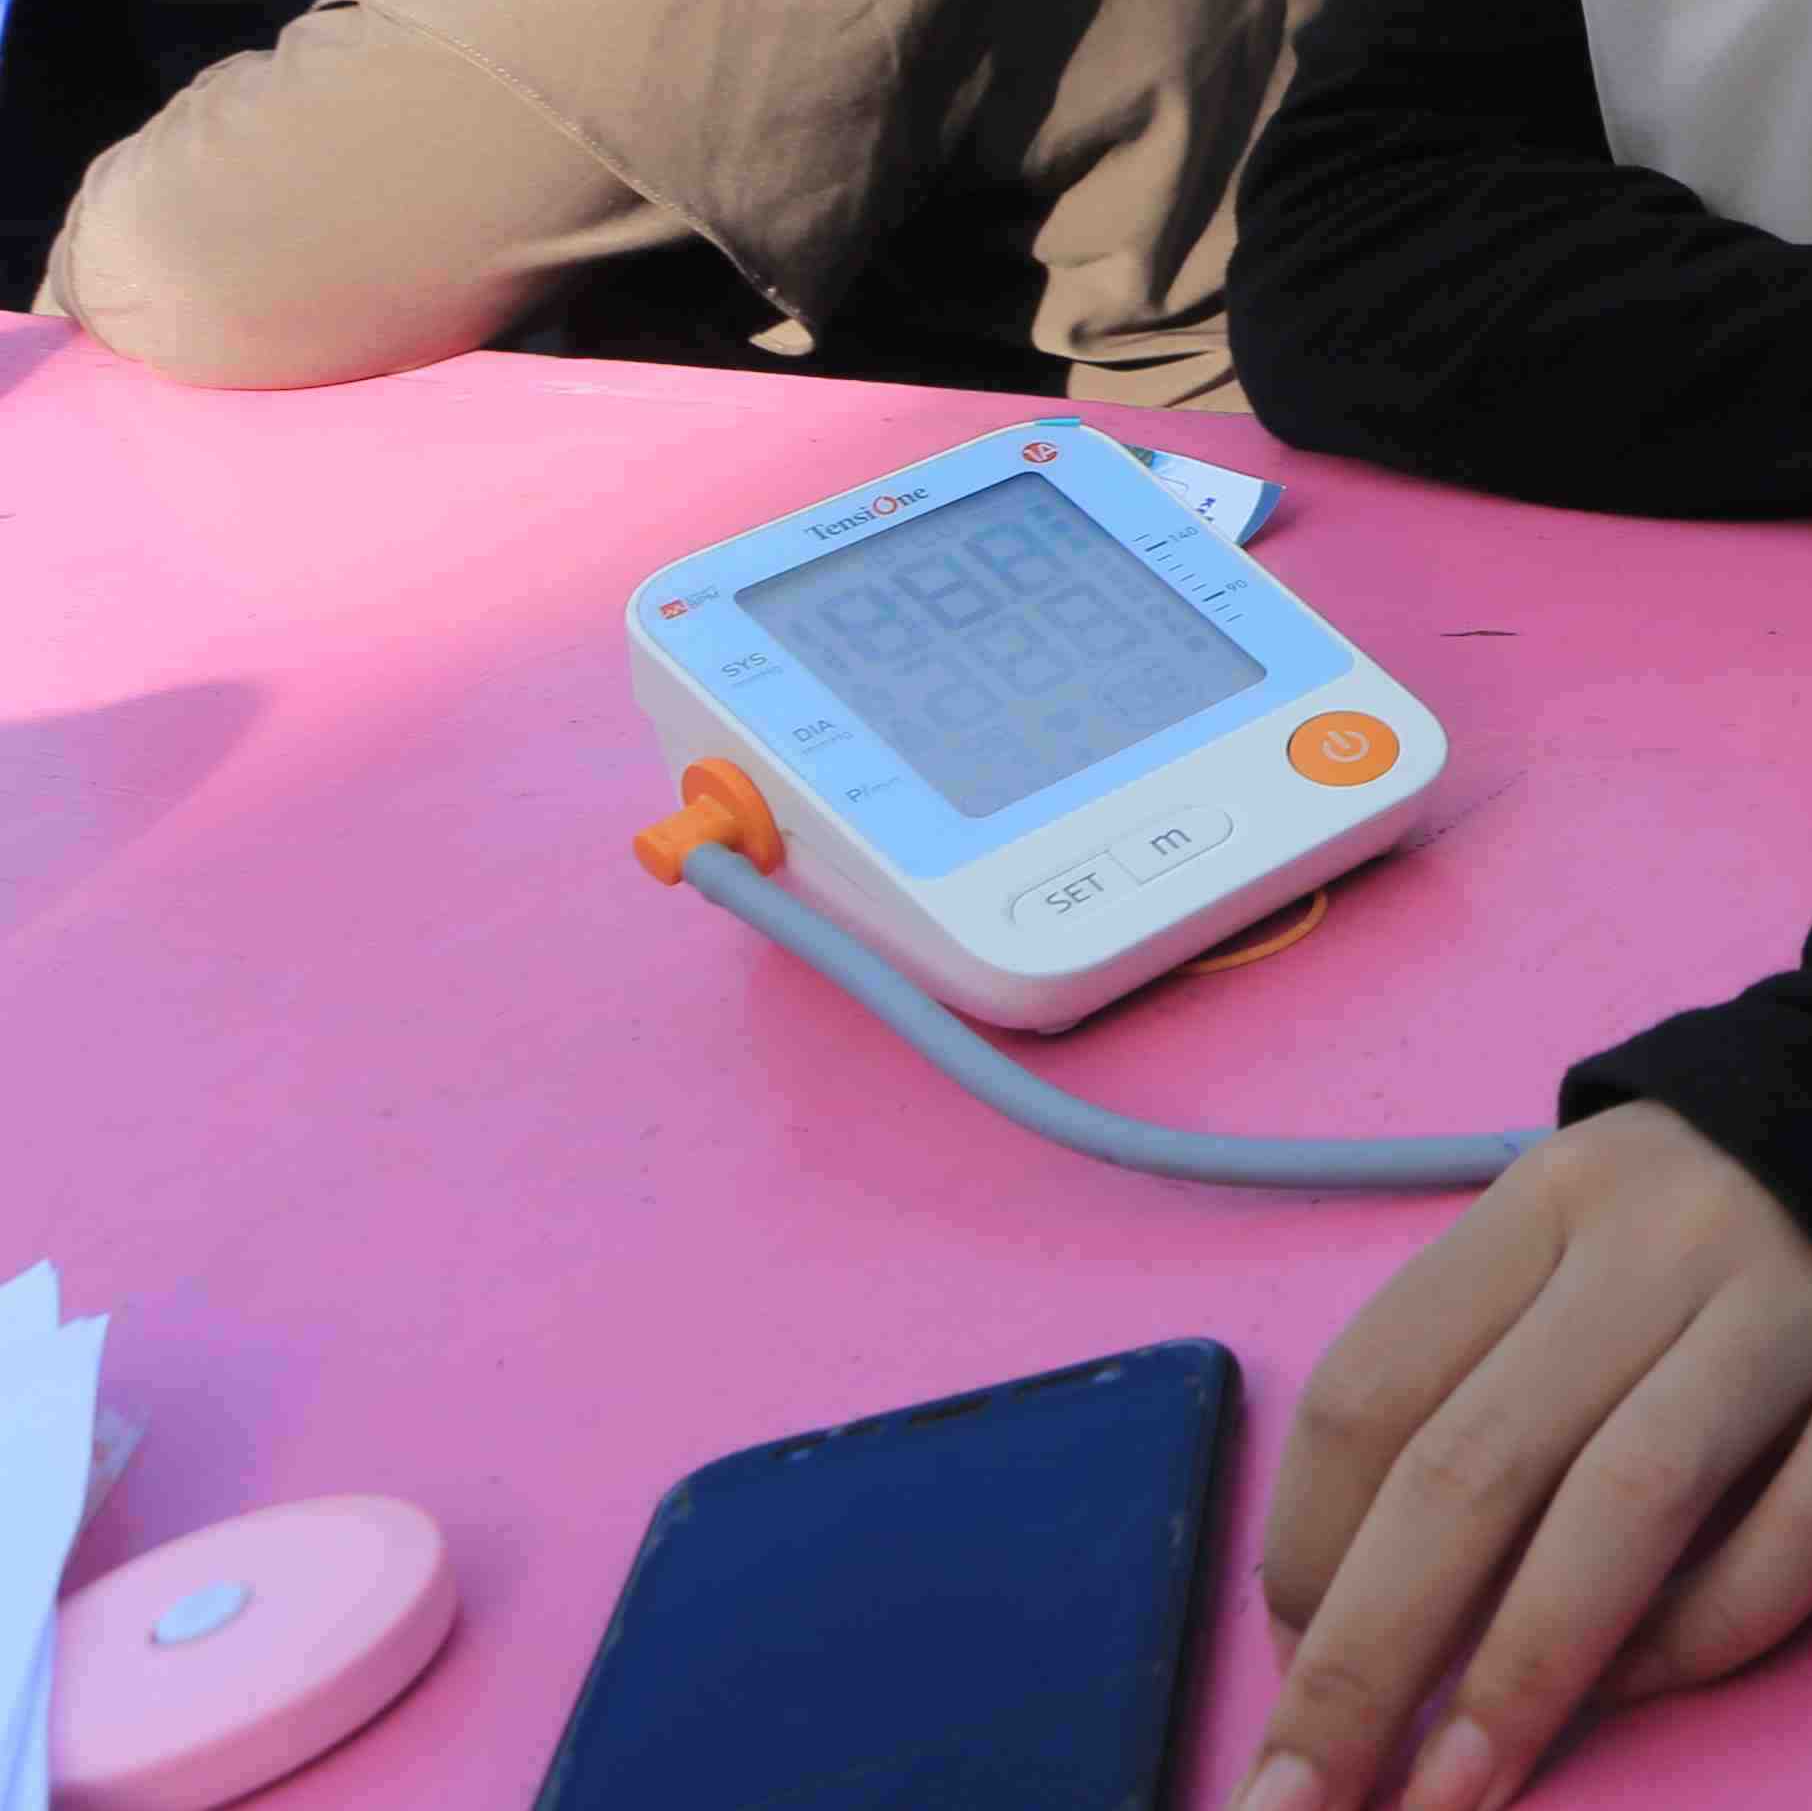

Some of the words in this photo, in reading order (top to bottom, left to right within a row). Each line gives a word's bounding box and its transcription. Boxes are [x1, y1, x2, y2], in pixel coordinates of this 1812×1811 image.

[804, 488, 928, 540] TensiOne
[1168, 526, 1199, 541] 140
[1225, 579, 1248, 594] 90
[721, 652, 767, 677] SYS
[792, 720, 834, 743] DIA
[1046, 872, 1104, 914] SET
